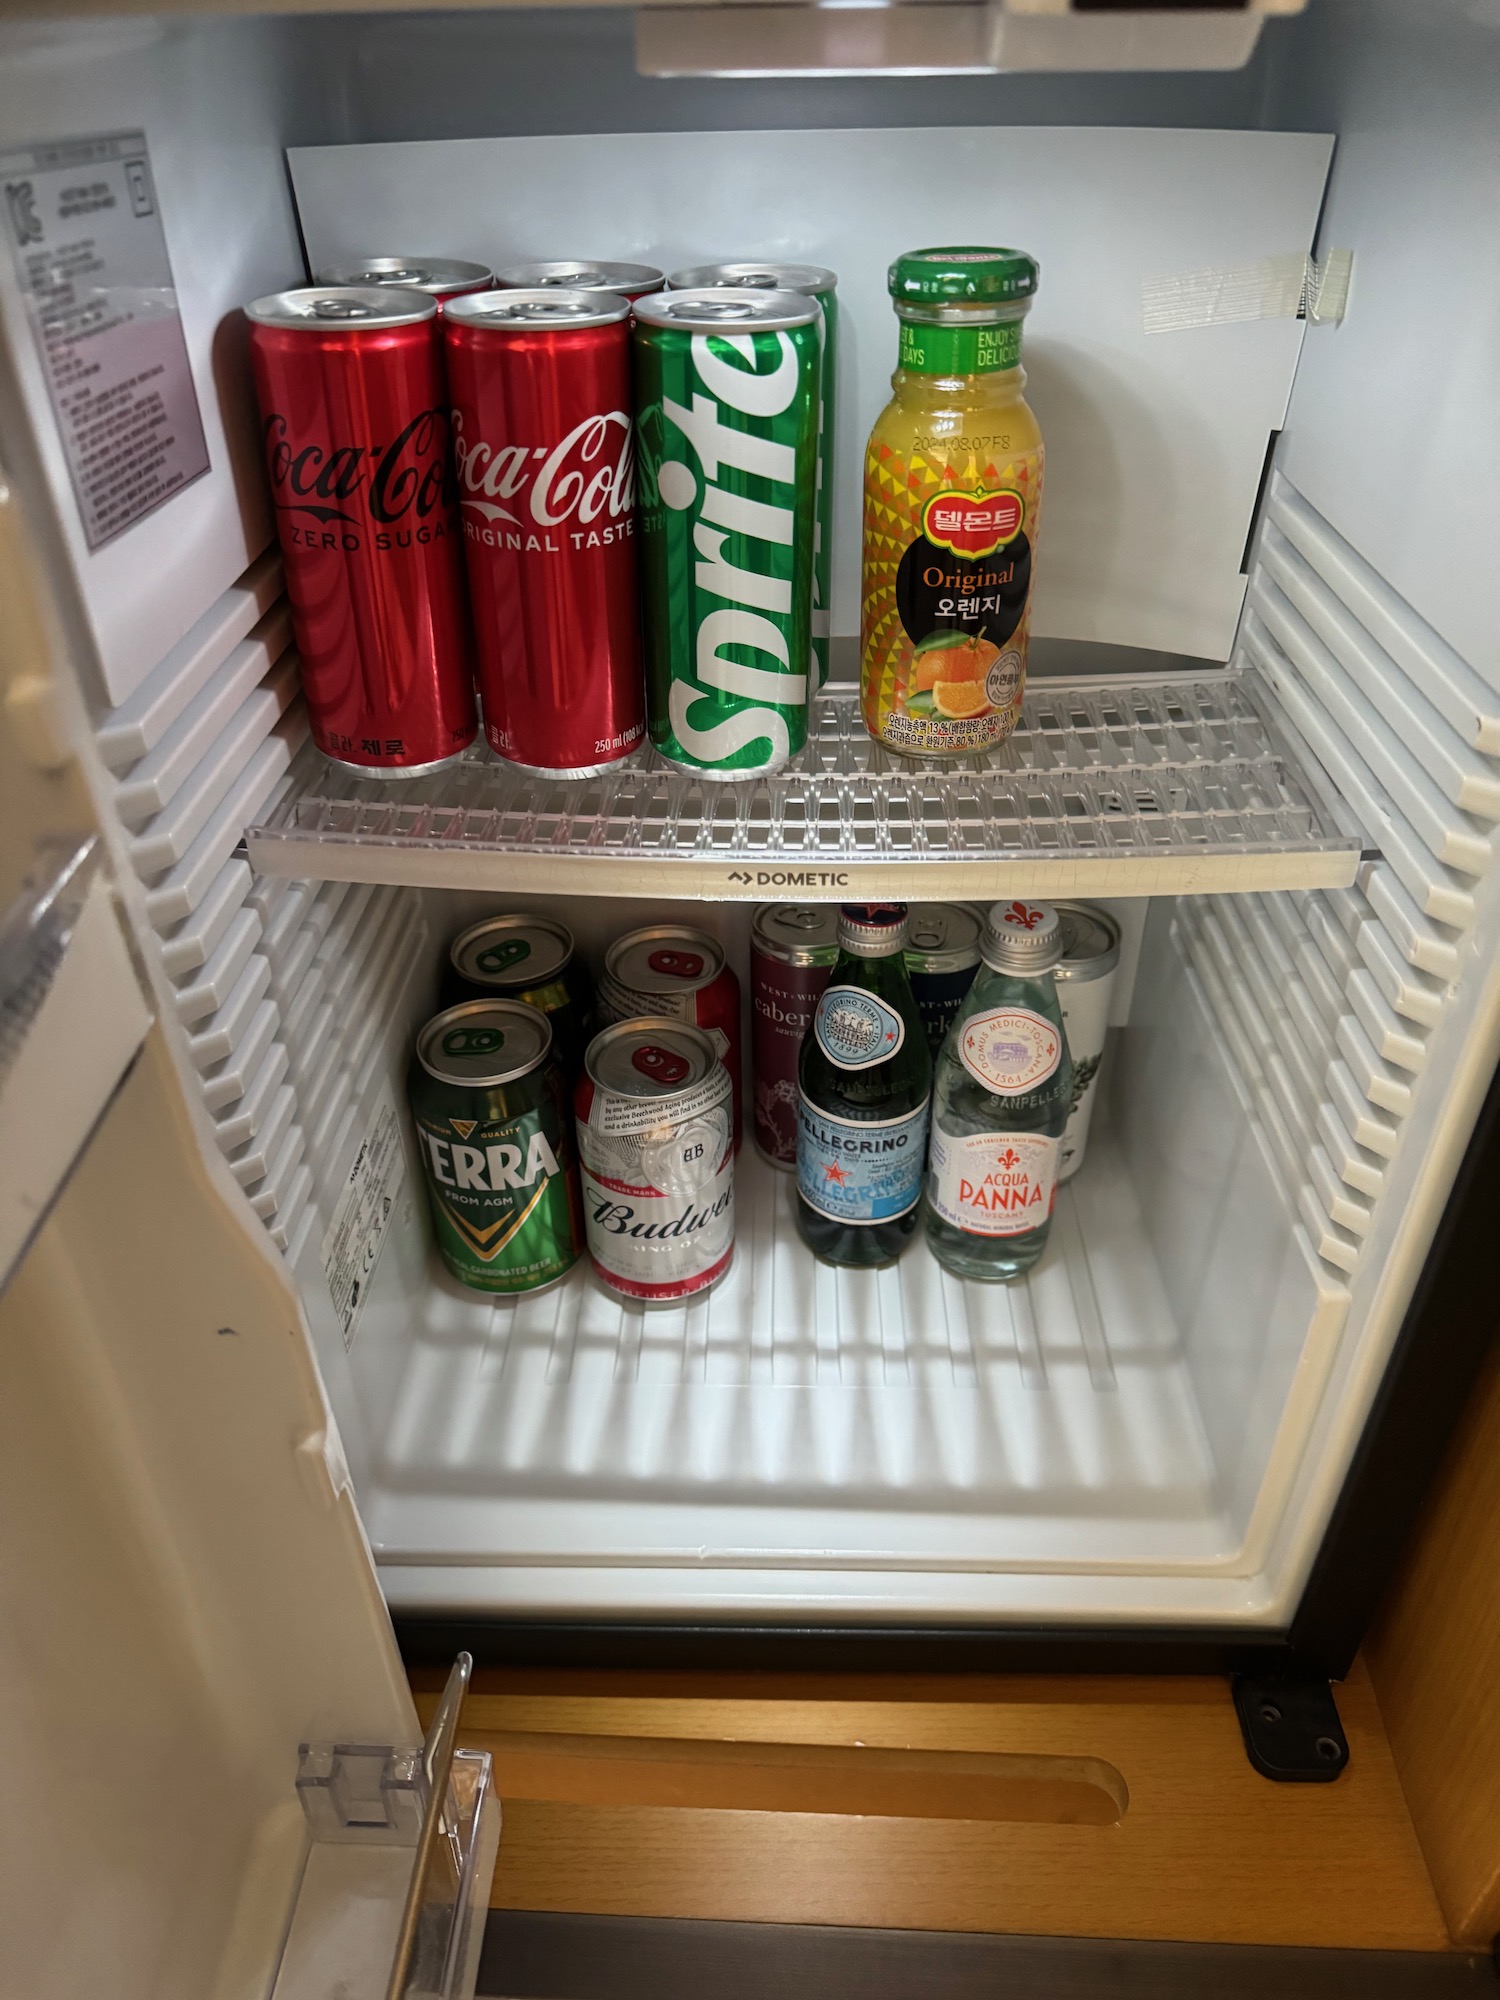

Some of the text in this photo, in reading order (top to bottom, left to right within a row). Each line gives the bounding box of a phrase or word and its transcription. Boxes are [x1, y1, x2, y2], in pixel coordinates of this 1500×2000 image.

[978, 331, 1008, 347] ENJOY
[903, 346, 924, 366] DAYS
[934, 508, 1016, 532] 델몬트
[291, 520, 452, 551] ZERO SUGA
[570, 518, 634, 550] TASTE
[658, 331, 807, 762] Sprite
[923, 561, 1014, 595] Original
[934, 594, 1001, 620] 오렌지
[929, 722, 938, 733] 13
[361, 739, 406, 756] 제로
[595, 738, 611, 754] 250
[757, 872, 848, 886] DOMETIC
[760, 981, 788, 999] WEST
[797, 993, 821, 1001] WIL
[860, 1003, 879, 1022] TERME
[863, 1033, 879, 1052] ITALIA
[978, 1032, 989, 1069] DOMUS
[989, 1019, 1026, 1032] MEDICI
[1030, 1027, 1044, 1073] TOSCANA
[995, 1073, 1022, 1084] 1564
[605, 1113, 630, 1121] exclusive
[631, 1105, 663, 1118] Beechwood
[664, 1102, 680, 1110] Aging
[681, 1091, 702, 1105] produces
[621, 1118, 656, 1129] drinkability
[669, 1109, 679, 1118] will
[480, 1126, 521, 1139] QUALITY
[609, 1183, 656, 1197] TRADE MARK
[984, 1173, 1029, 1187] ACQUA
[445, 1190, 513, 1207] FROM AGM
[959, 1178, 1042, 1211] PANNA
[470, 1264, 528, 1277] CARBONATED
[529, 1257, 551, 1270] BEER
